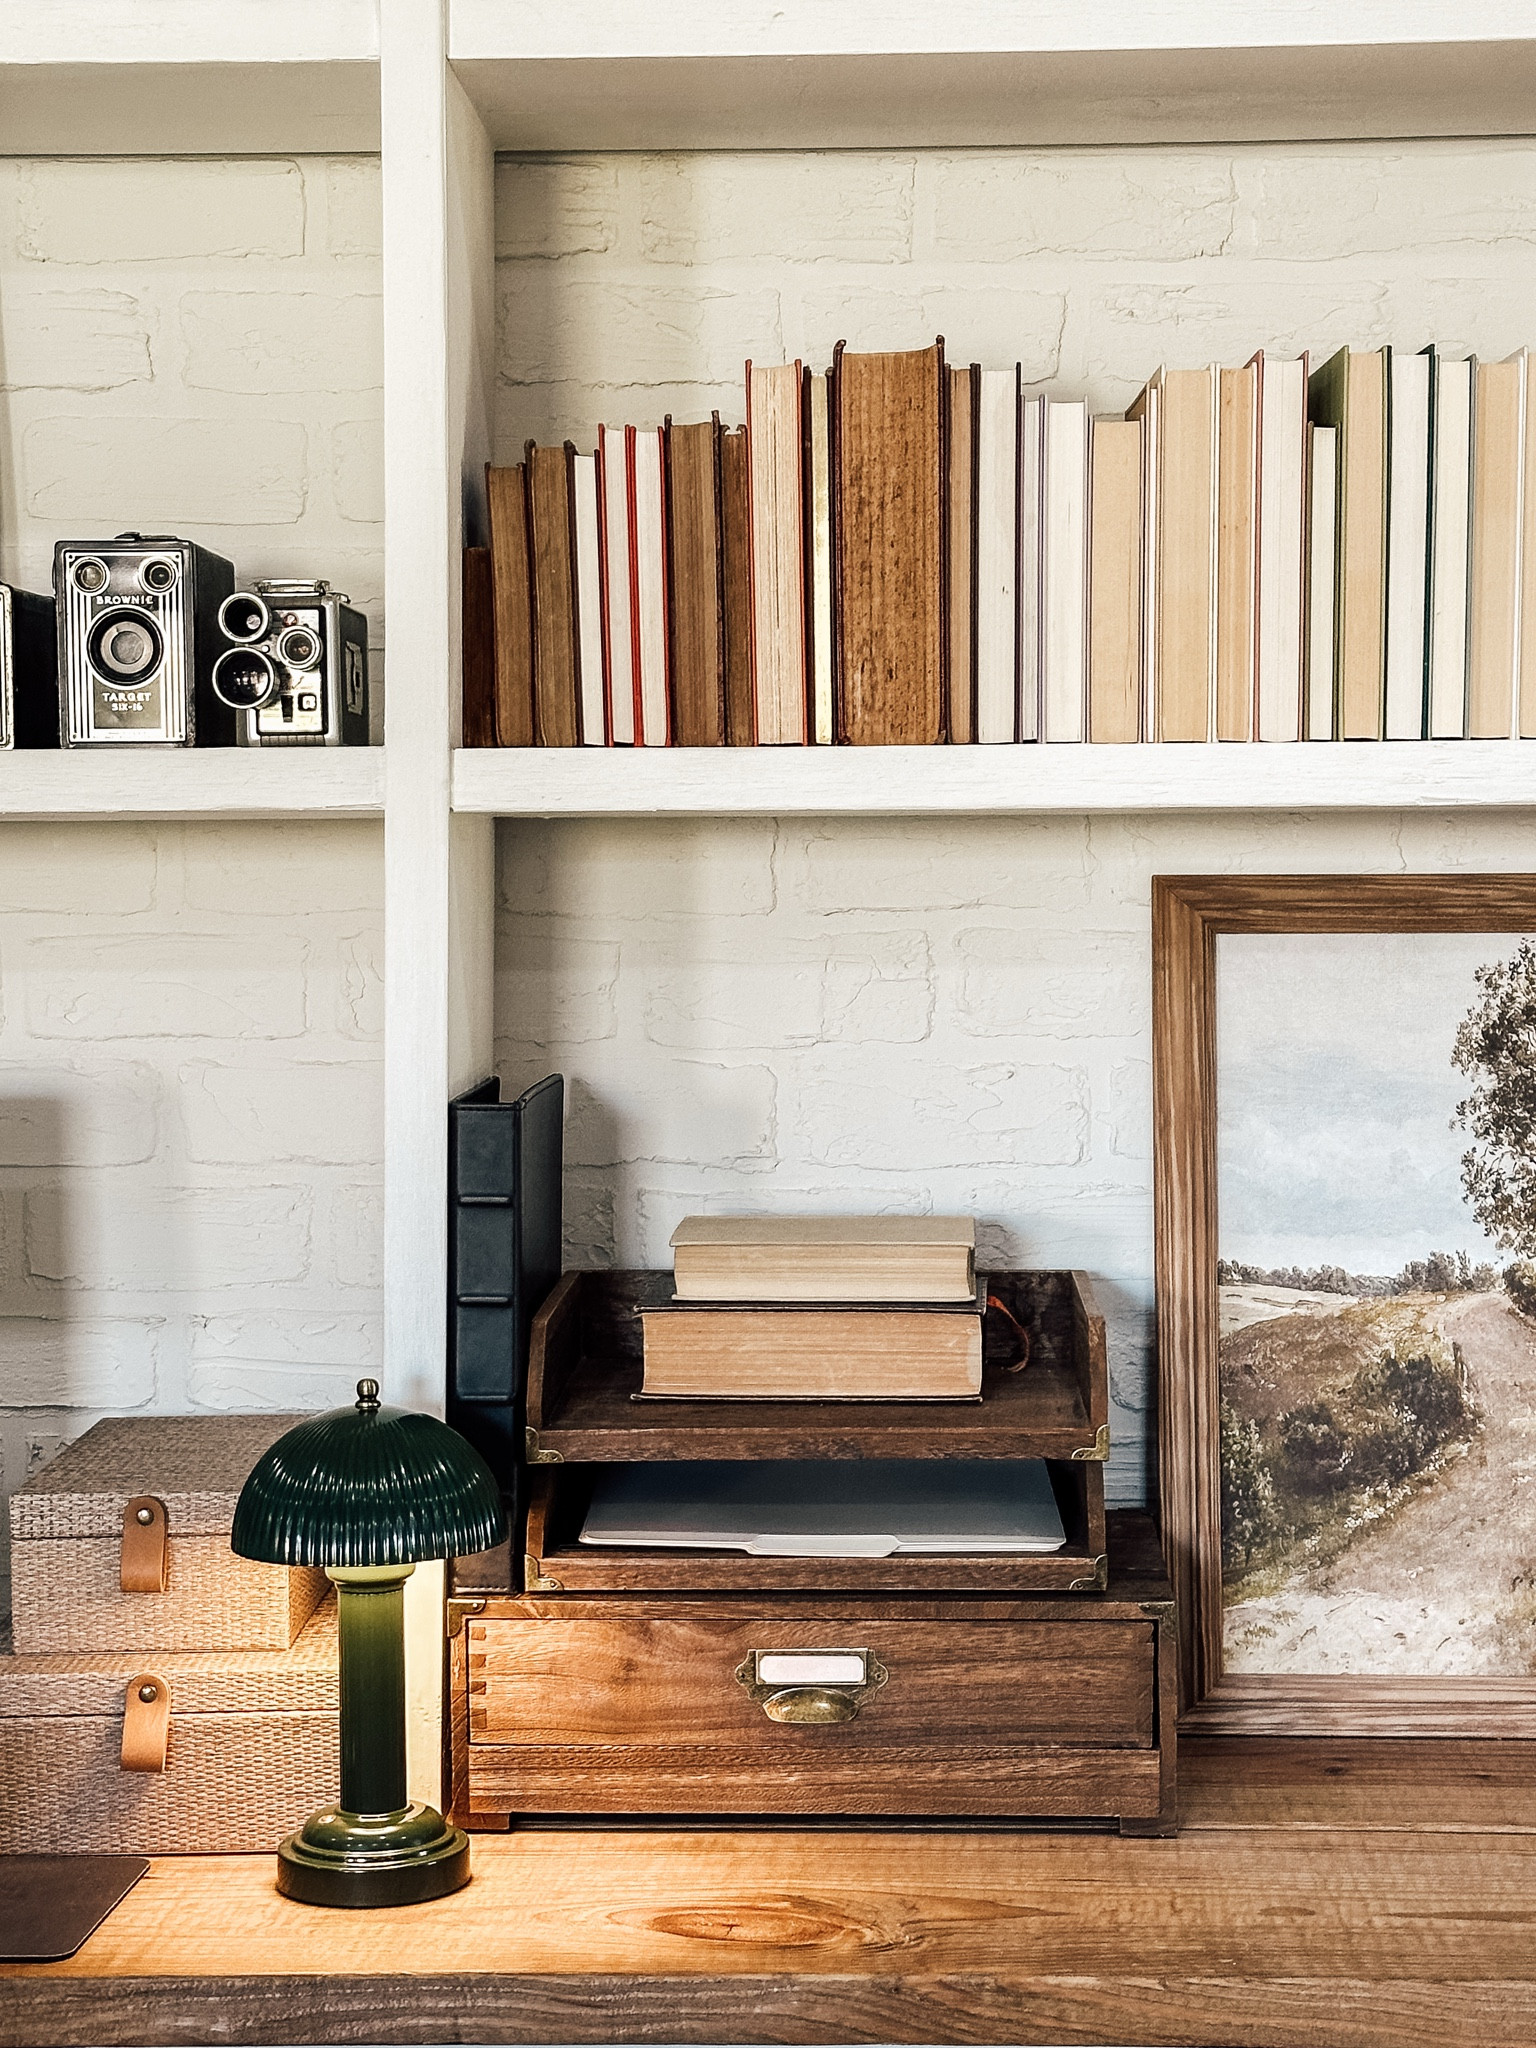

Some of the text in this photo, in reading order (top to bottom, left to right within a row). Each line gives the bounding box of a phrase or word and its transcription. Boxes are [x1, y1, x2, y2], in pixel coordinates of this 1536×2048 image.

[95, 595, 154, 605] BROWNIE
[102, 692, 152, 702] TARGET
[111, 703, 144, 712] SIX-16
